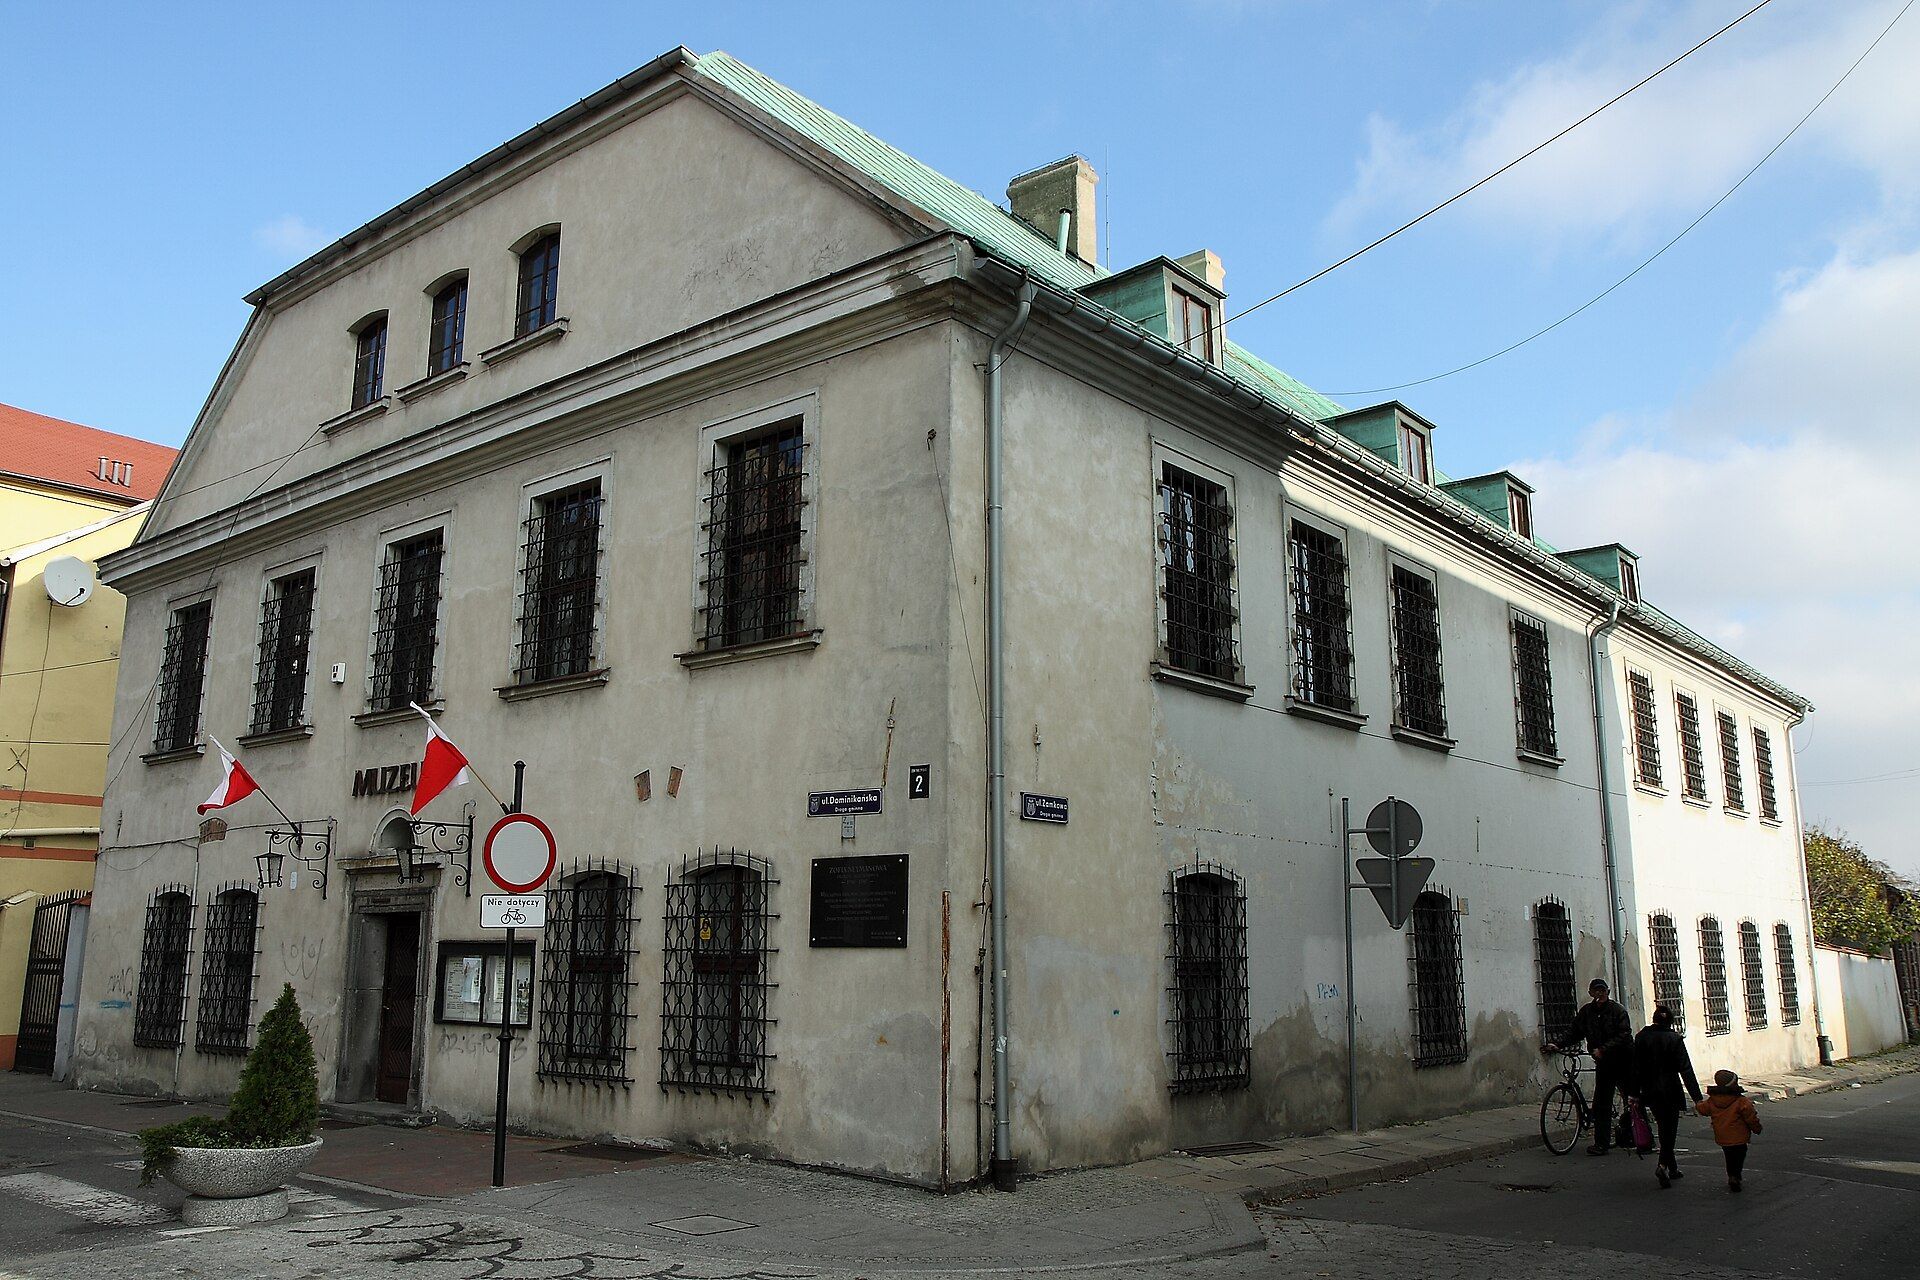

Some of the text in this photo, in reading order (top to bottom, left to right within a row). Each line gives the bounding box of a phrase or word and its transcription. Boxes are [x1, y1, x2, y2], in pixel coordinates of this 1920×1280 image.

[915, 775, 923, 792] 2
[487, 898, 540, 907] Nie dotyczy
